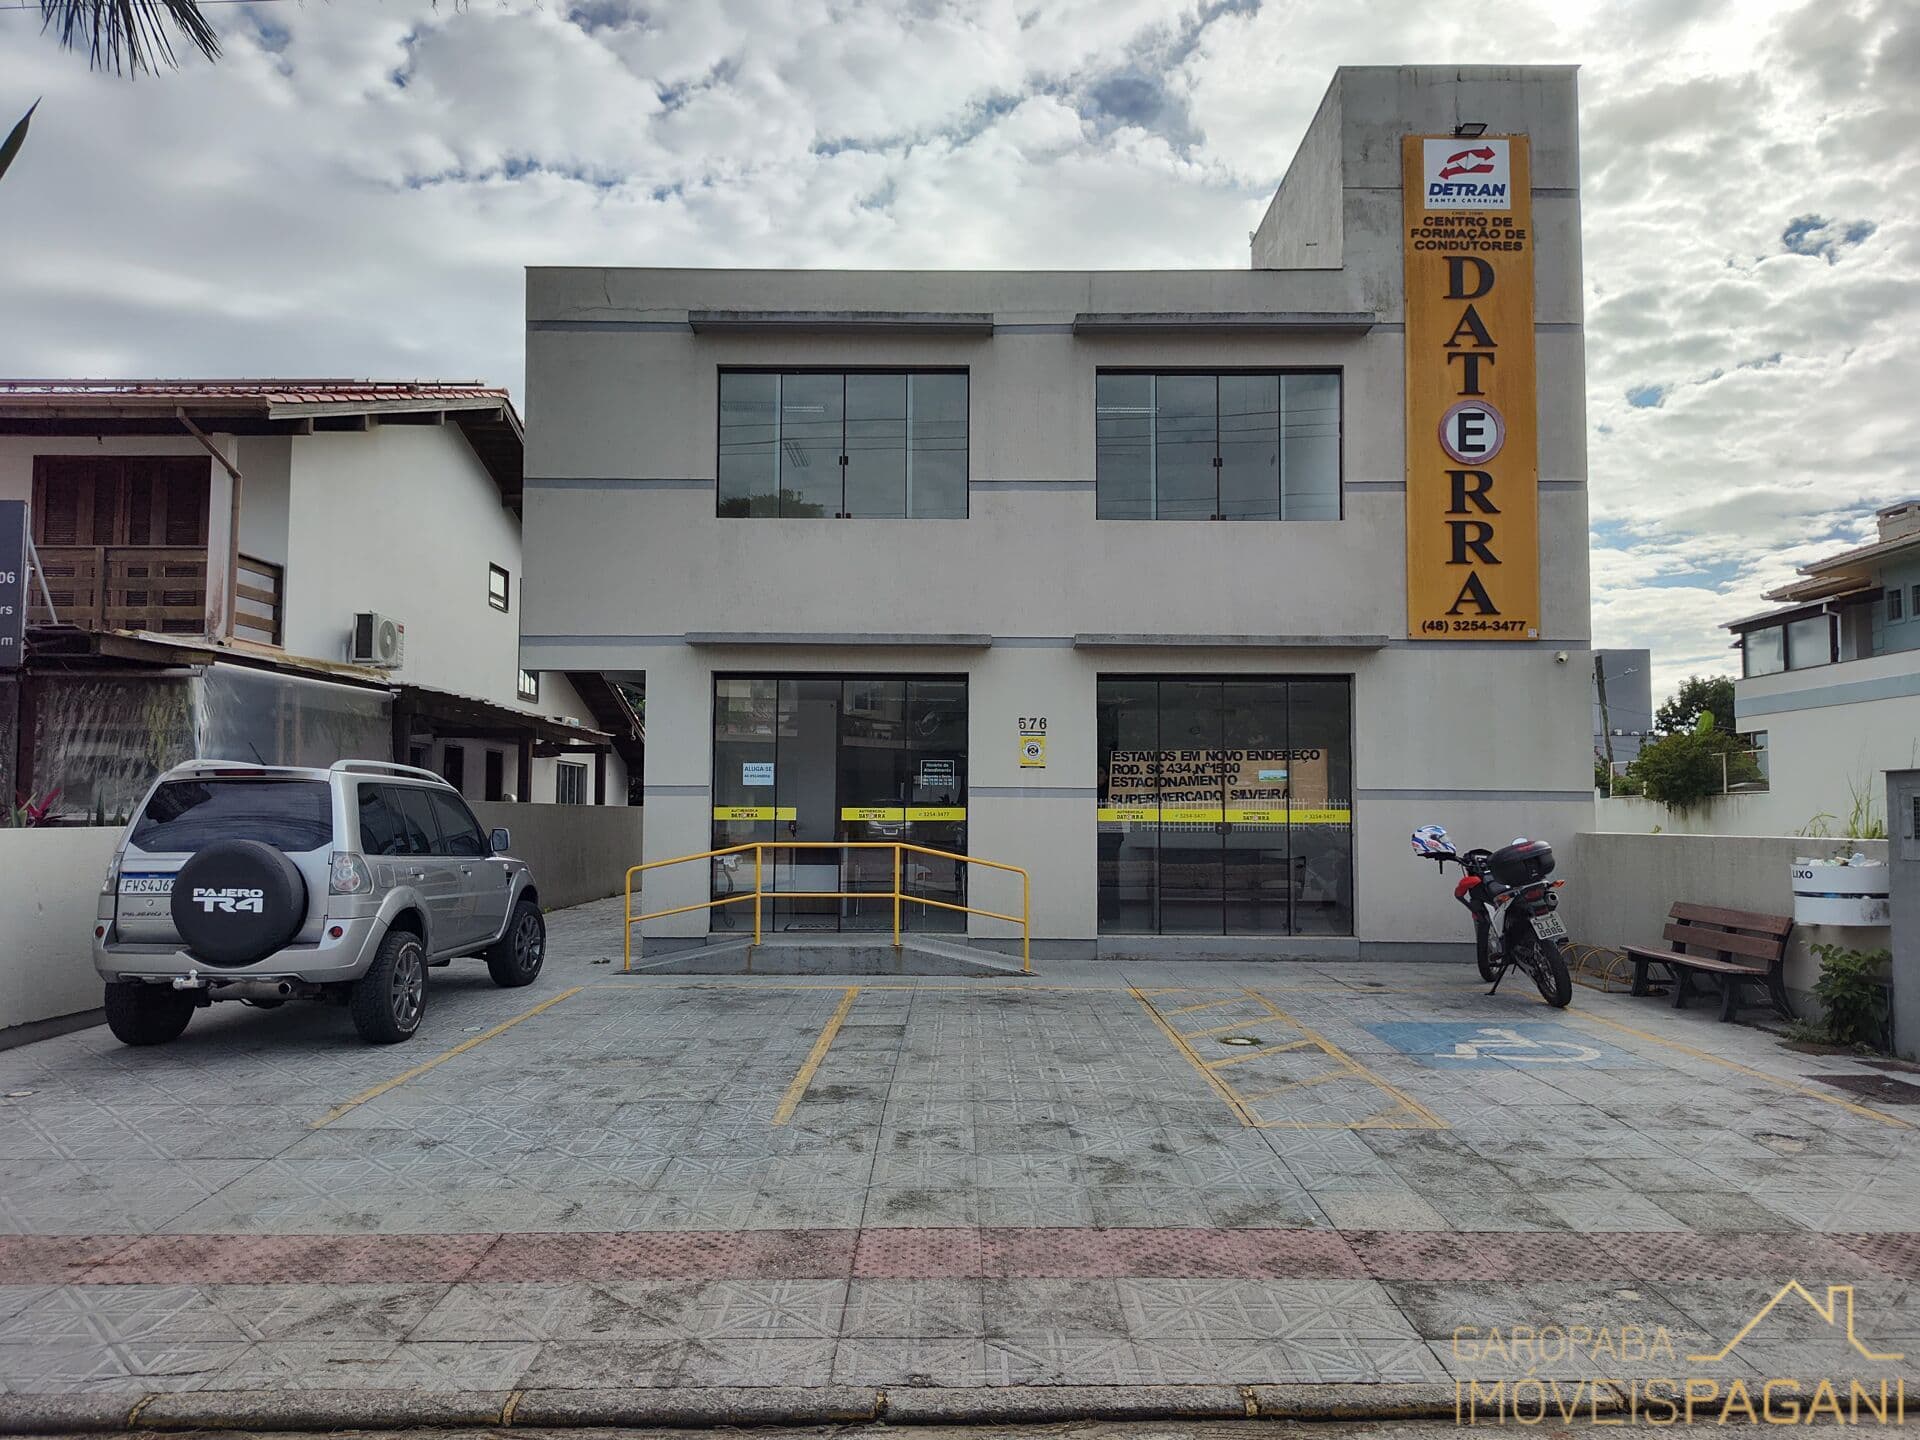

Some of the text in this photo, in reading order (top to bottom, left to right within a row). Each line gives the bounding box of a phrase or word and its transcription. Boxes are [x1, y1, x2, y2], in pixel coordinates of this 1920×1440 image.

[1428, 183, 1506, 196] DETRAN
[1423, 216, 1513, 227] CENTRO DE
[1411, 227, 1526, 240] FORMAÇÃO DE
[1414, 240, 1523, 251] CONDUTORES
[1441, 255, 1503, 616] DATERRA
[1421, 620, 1527, 633] (48) 3254-3477
[1018, 717, 1047, 730] 576
[1111, 749, 1321, 764] ESTAMOS EM NOVO ENDEREÇO
[1111, 764, 1143, 775] ROD.
[1146, 763, 1165, 775] SC
[1111, 775, 1238, 788] ESTACIONAMENTO
[1111, 790, 1223, 804] SUPERMERCADO
[1792, 870, 1813, 879] LIXO
[193, 888, 264, 898] PAJERO
[192, 898, 264, 913] TR4
